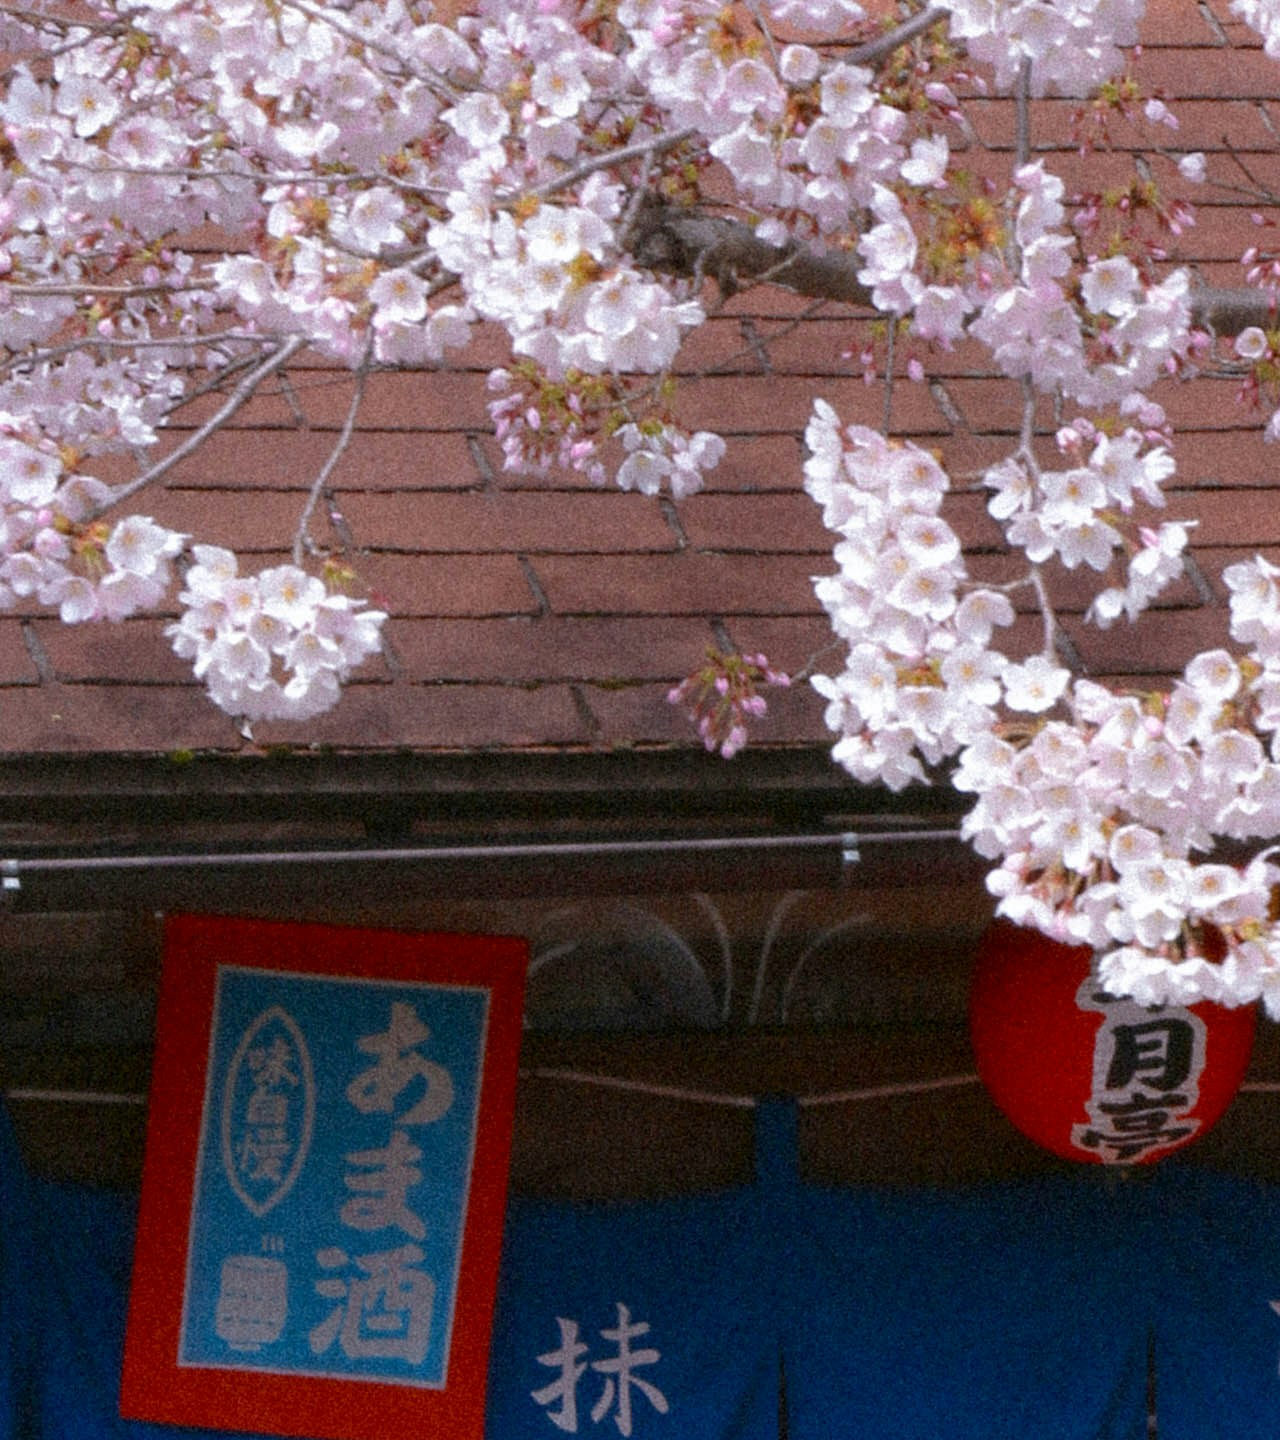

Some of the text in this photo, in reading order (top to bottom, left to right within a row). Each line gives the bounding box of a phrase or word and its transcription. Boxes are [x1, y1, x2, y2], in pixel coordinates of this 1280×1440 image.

[240, 1036, 299, 1182] 味自慢
[1080, 991, 1195, 1159] 月亭
[309, 1001, 454, 1364] あま酒
